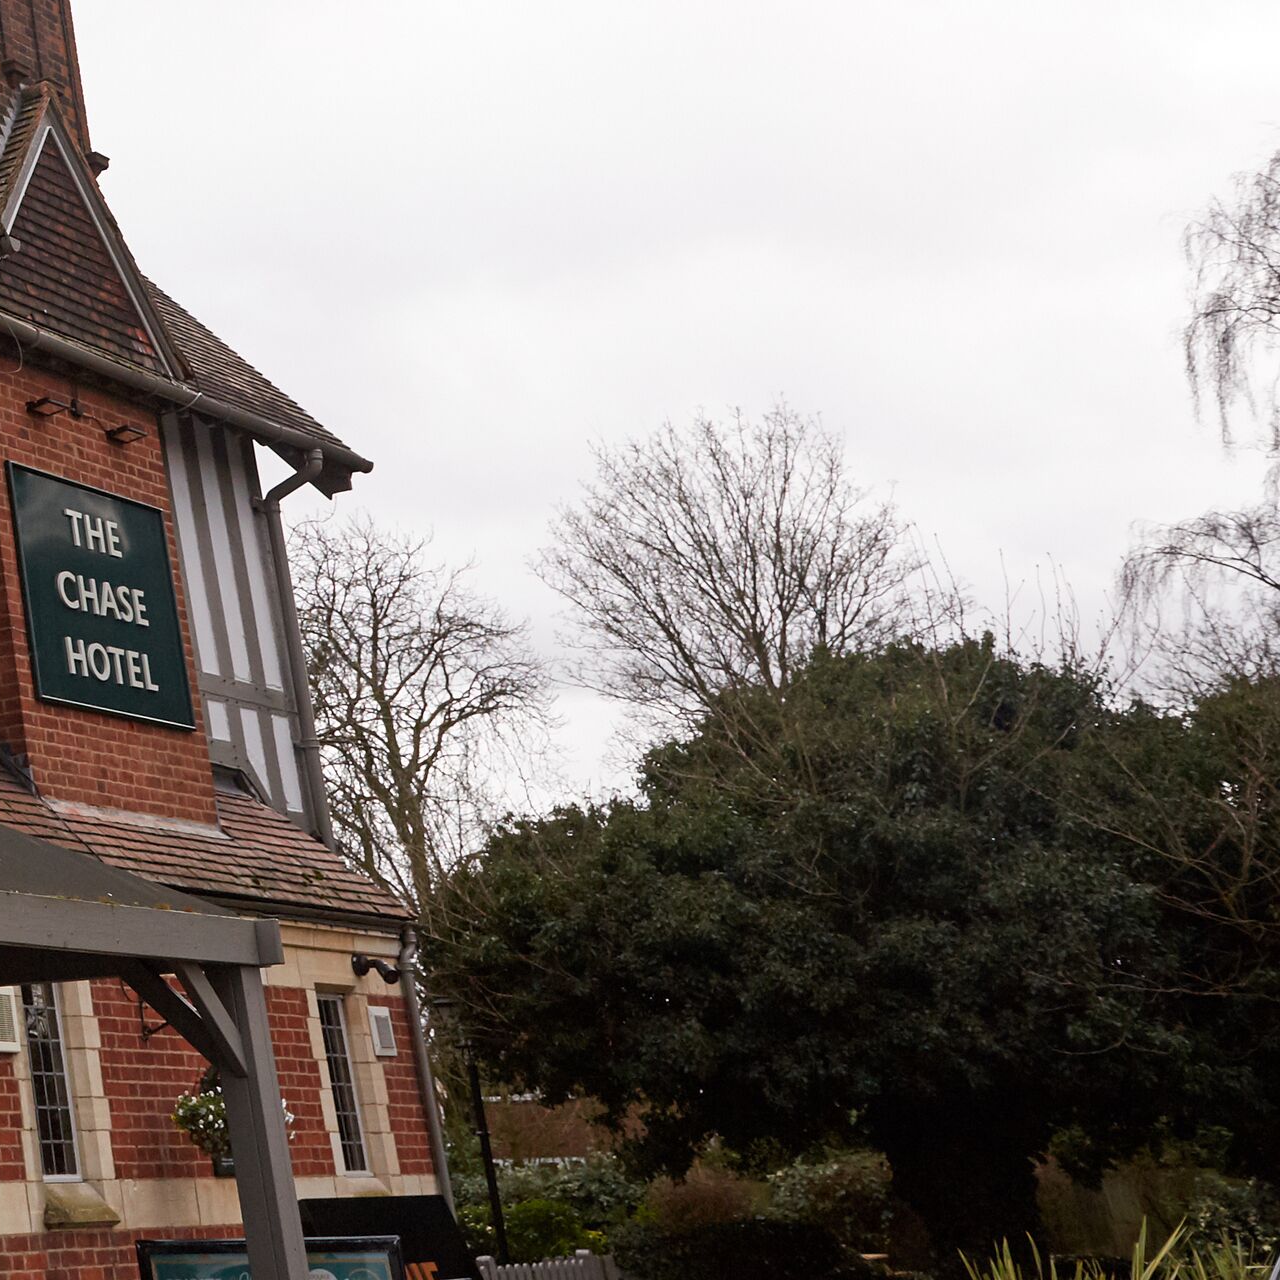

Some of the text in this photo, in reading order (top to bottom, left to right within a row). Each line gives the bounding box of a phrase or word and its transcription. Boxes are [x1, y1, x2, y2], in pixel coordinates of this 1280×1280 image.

[64, 508, 123, 558] THE
[57, 570, 150, 627] CHASE
[64, 636, 160, 692] HOTEL
